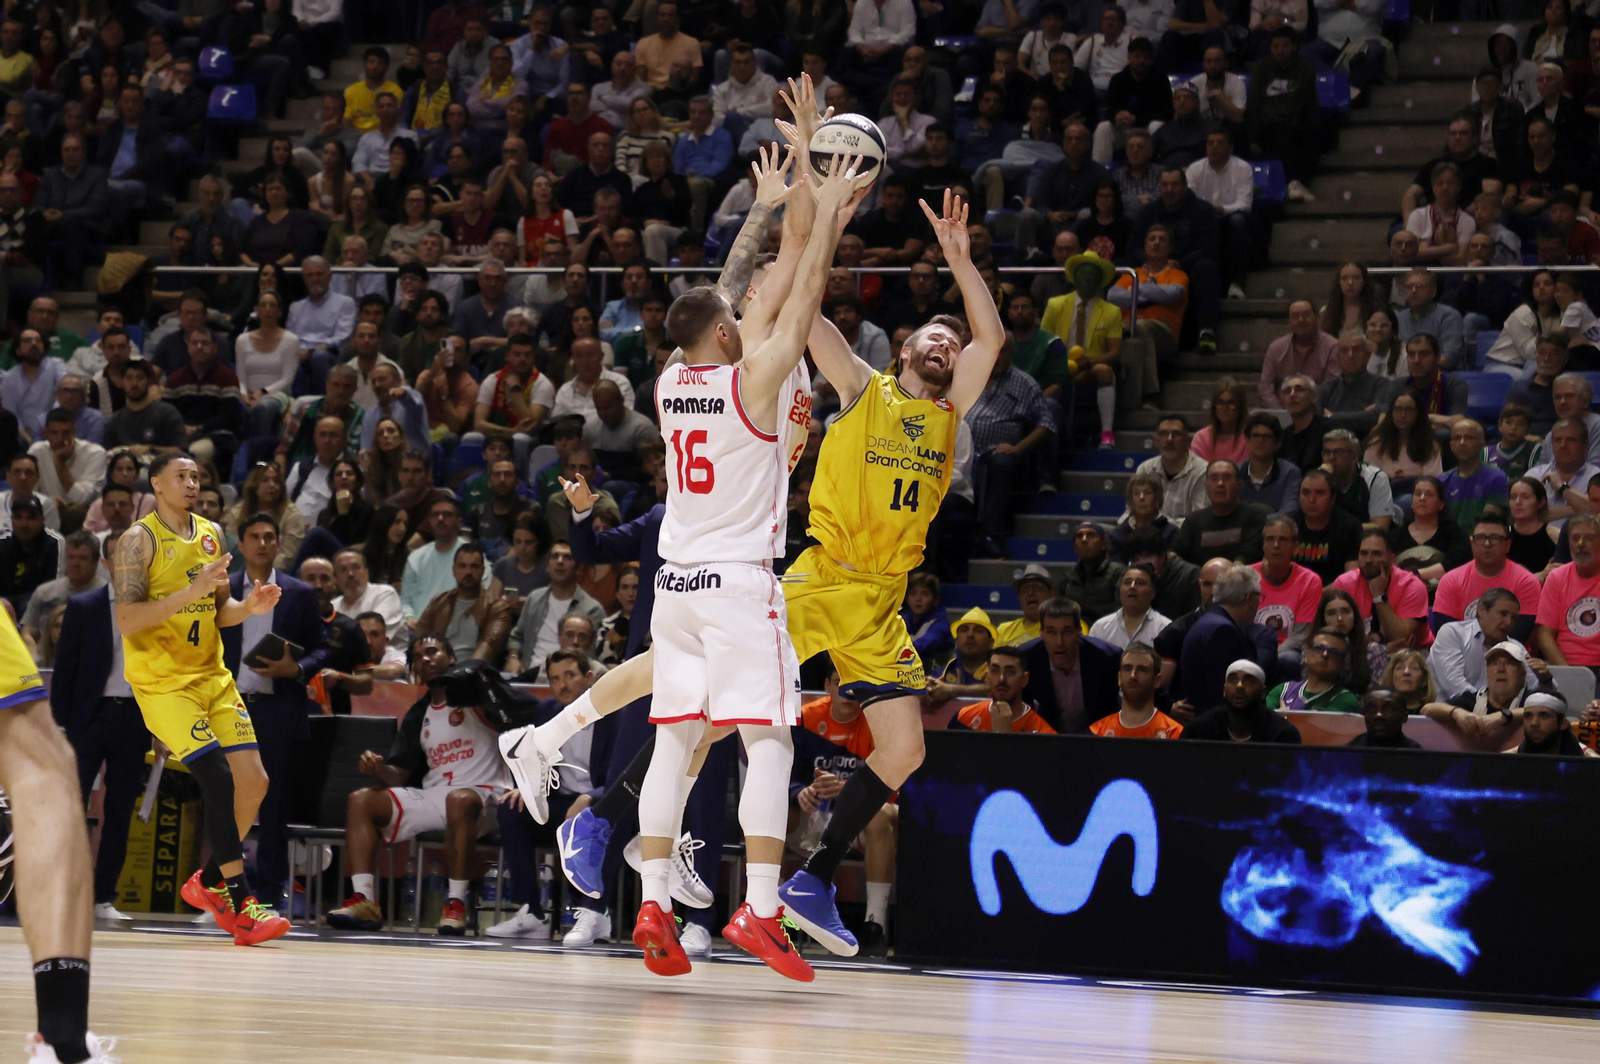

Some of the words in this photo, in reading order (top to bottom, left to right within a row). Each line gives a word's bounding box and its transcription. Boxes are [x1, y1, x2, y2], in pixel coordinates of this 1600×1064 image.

[843, 135, 860, 148] 2024
[663, 397, 725, 414] PAMESA
[867, 435, 946, 463] DREAMLAND
[670, 430, 714, 494] 16
[890, 478, 919, 512] 14
[657, 568, 721, 592] Vitaldín
[187, 620, 200, 646] 4
[442, 771, 453, 786] 7
